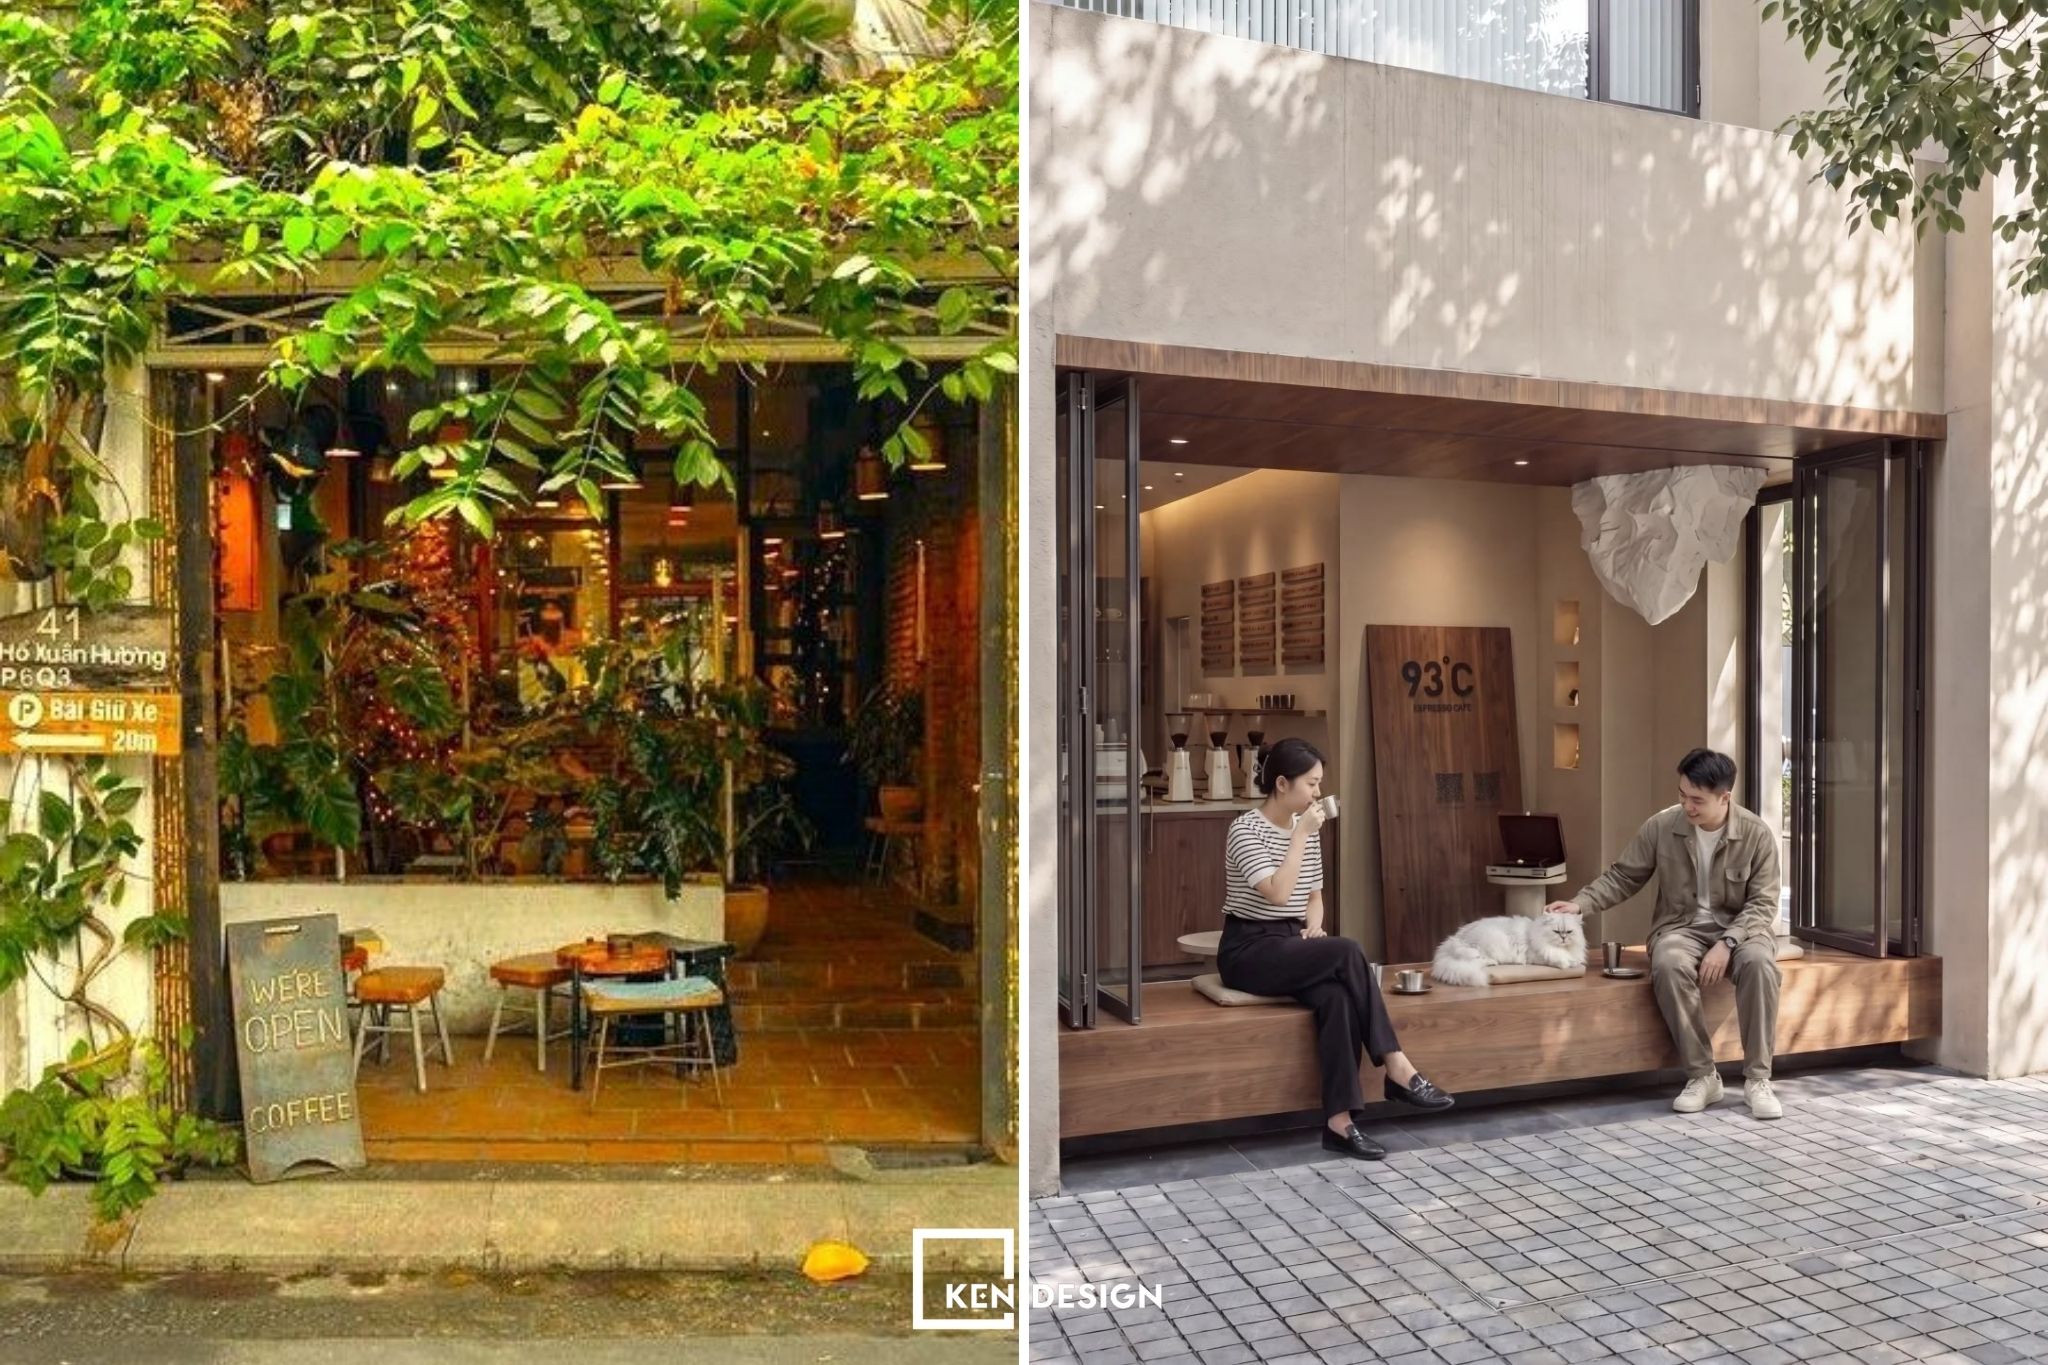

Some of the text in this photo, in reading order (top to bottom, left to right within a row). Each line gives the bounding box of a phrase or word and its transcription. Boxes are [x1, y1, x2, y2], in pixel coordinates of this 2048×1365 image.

[36, 607, 80, 641] 41
[35, 643, 87, 664] Xuân
[131, 699, 158, 723] Xe
[112, 730, 157, 752] 20m
[245, 1007, 343, 1053] OPEN
[250, 1092, 353, 1134] COFFEE
